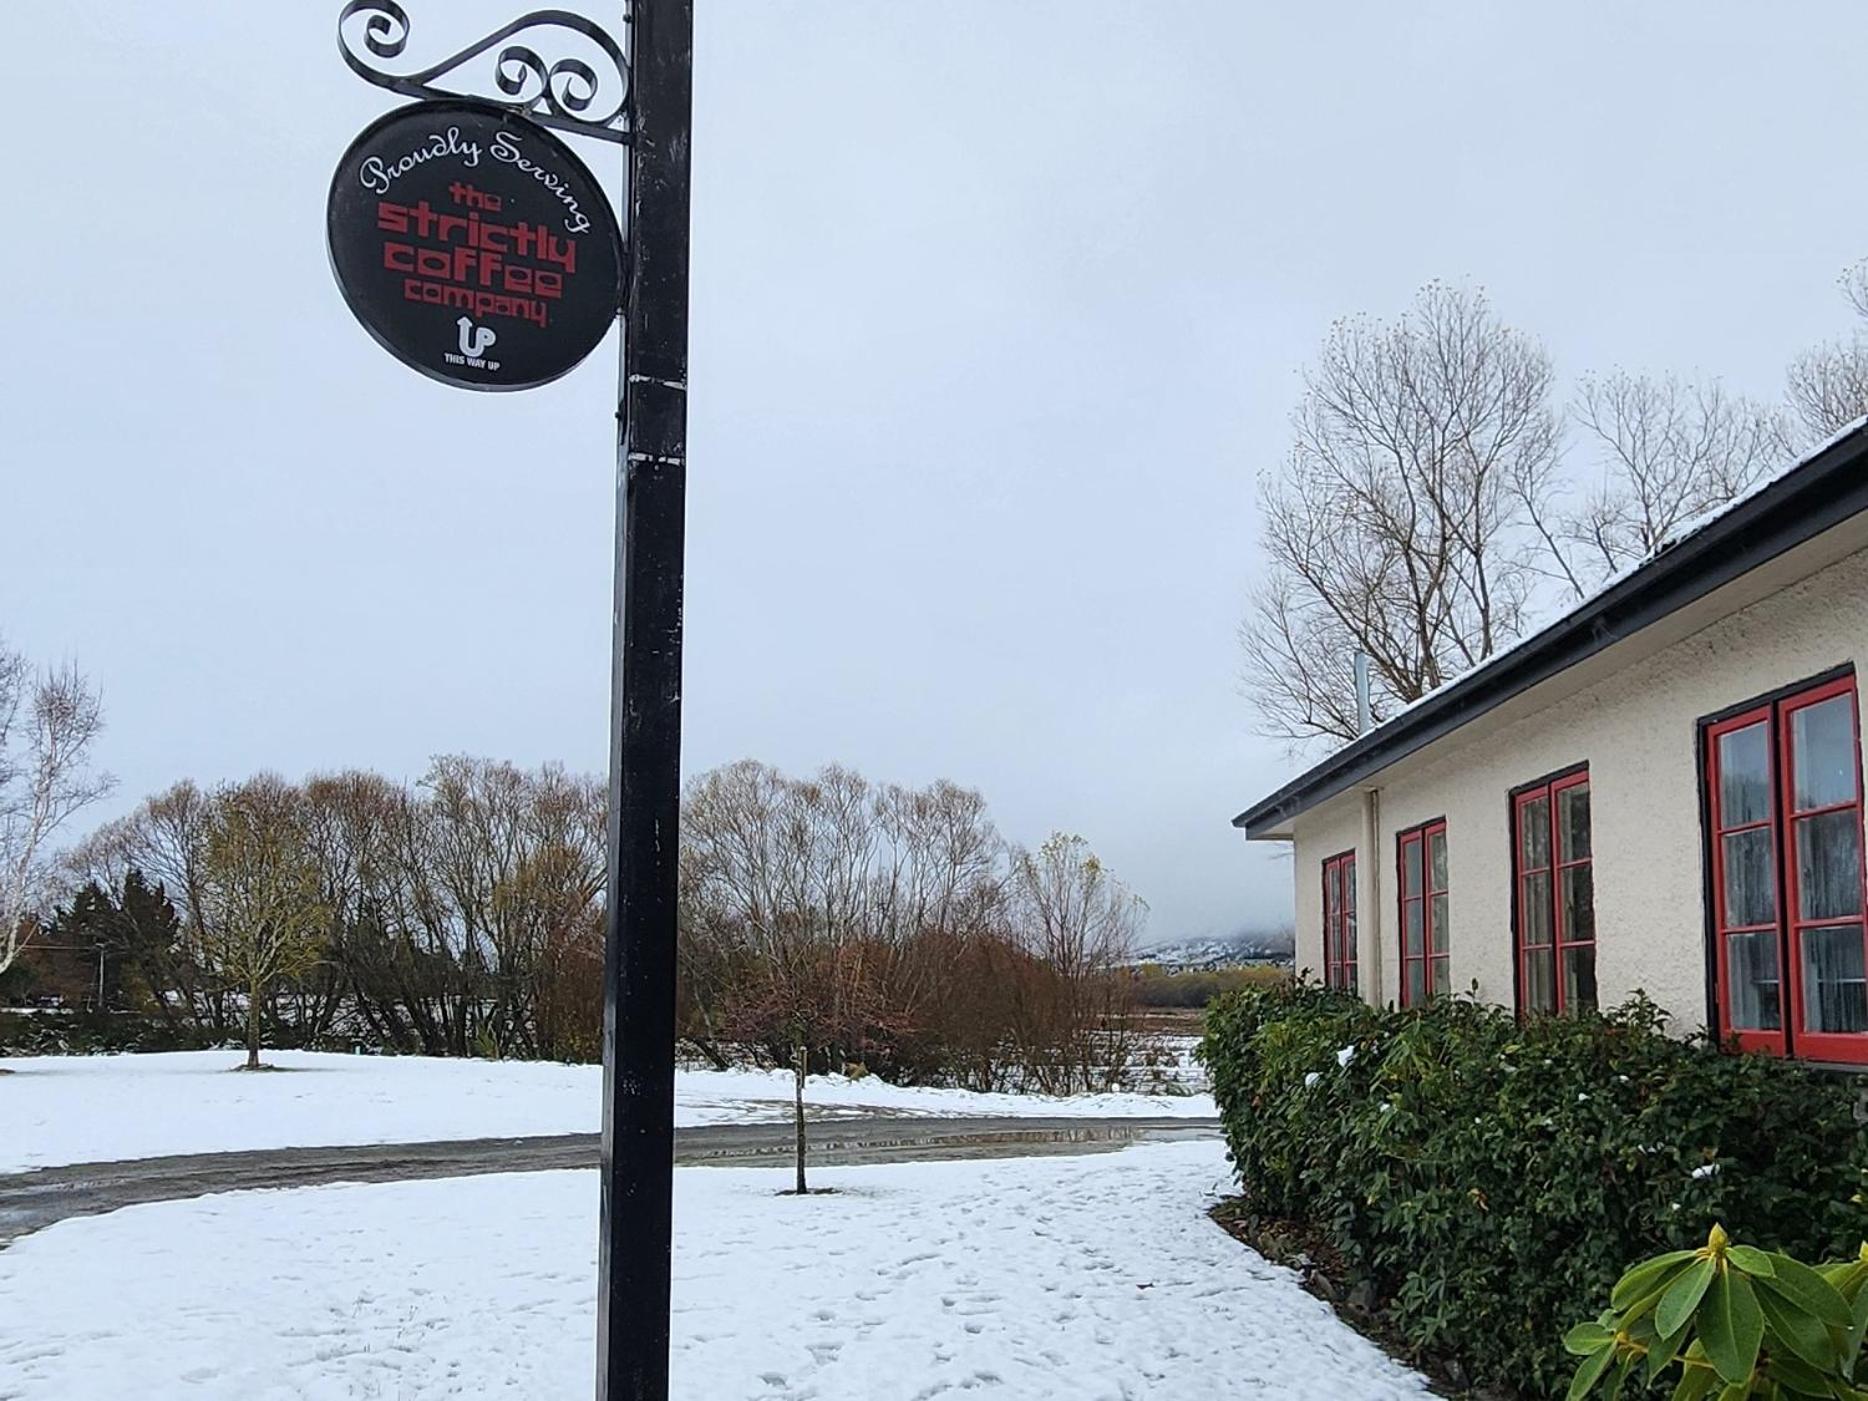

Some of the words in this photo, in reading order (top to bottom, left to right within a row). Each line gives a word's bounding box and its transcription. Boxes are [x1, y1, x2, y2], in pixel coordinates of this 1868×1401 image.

[360, 127, 482, 194] Proudly
[490, 131, 591, 234] Serving
[449, 181, 501, 211] the
[377, 200, 576, 273] strictly
[384, 241, 563, 298] coffee
[404, 279, 547, 327] company
[444, 353, 465, 366] THIS
[466, 356, 486, 369] WAY
[487, 360, 500, 370] UP
